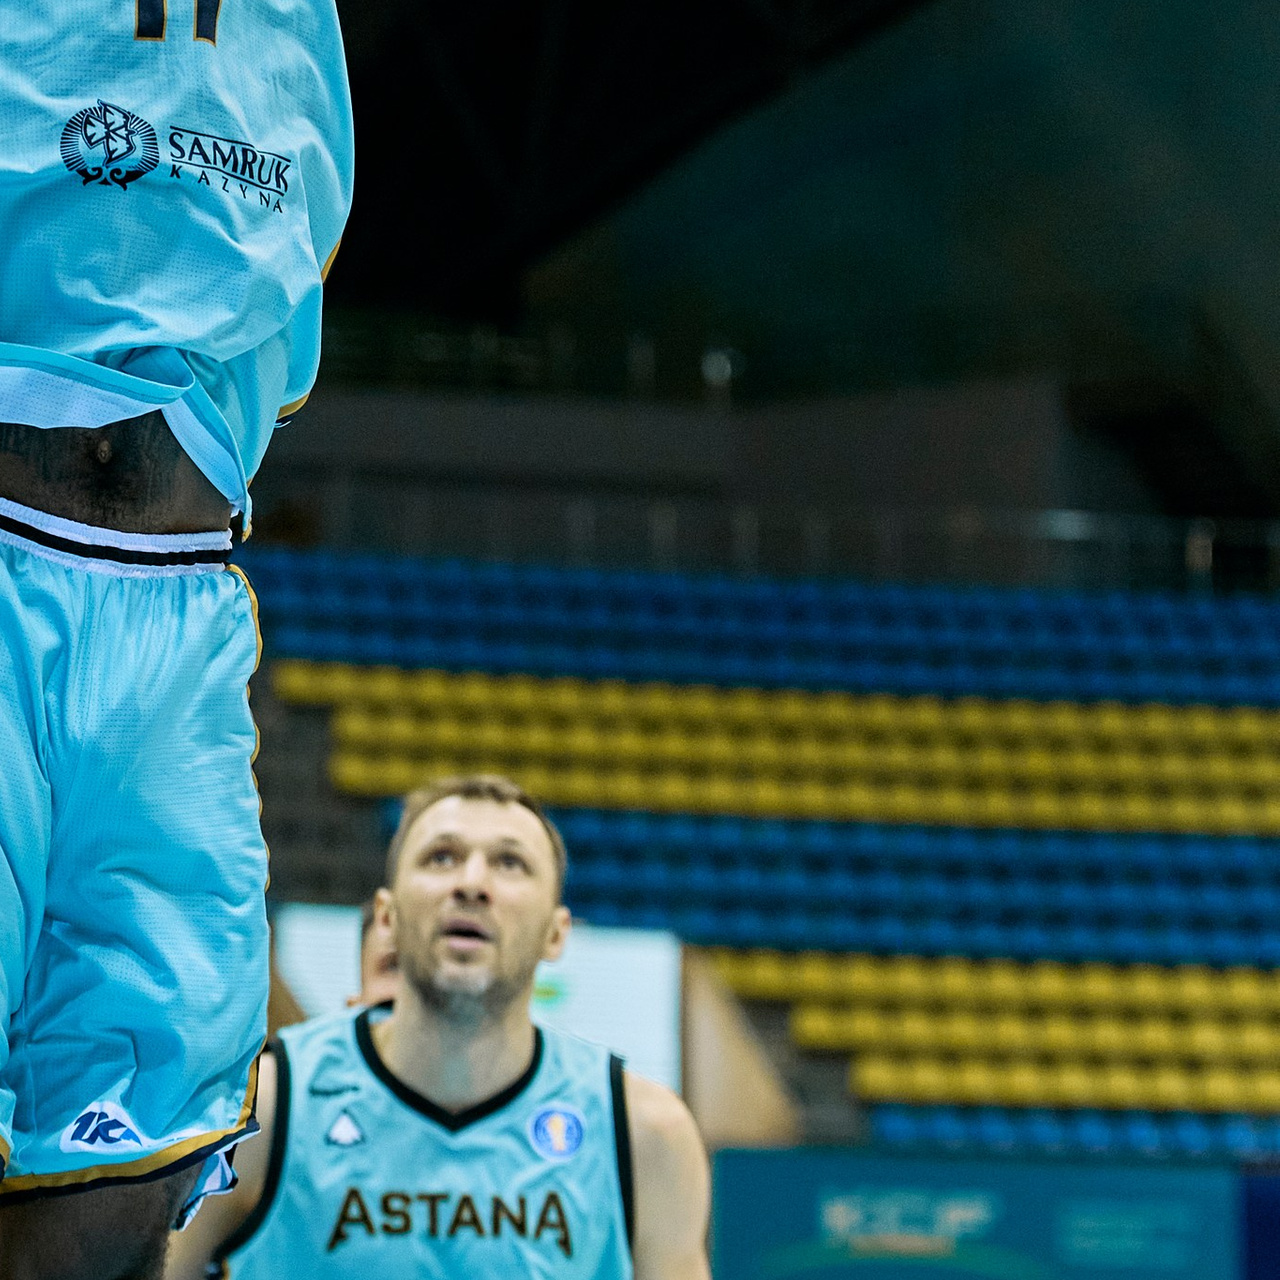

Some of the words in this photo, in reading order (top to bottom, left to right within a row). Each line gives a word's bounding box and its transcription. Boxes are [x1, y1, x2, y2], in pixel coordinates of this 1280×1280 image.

[169, 131, 291, 192] SAMRUK
[170, 164, 283, 213] KAZYNA
[327, 1186, 573, 1258] ASTANA
